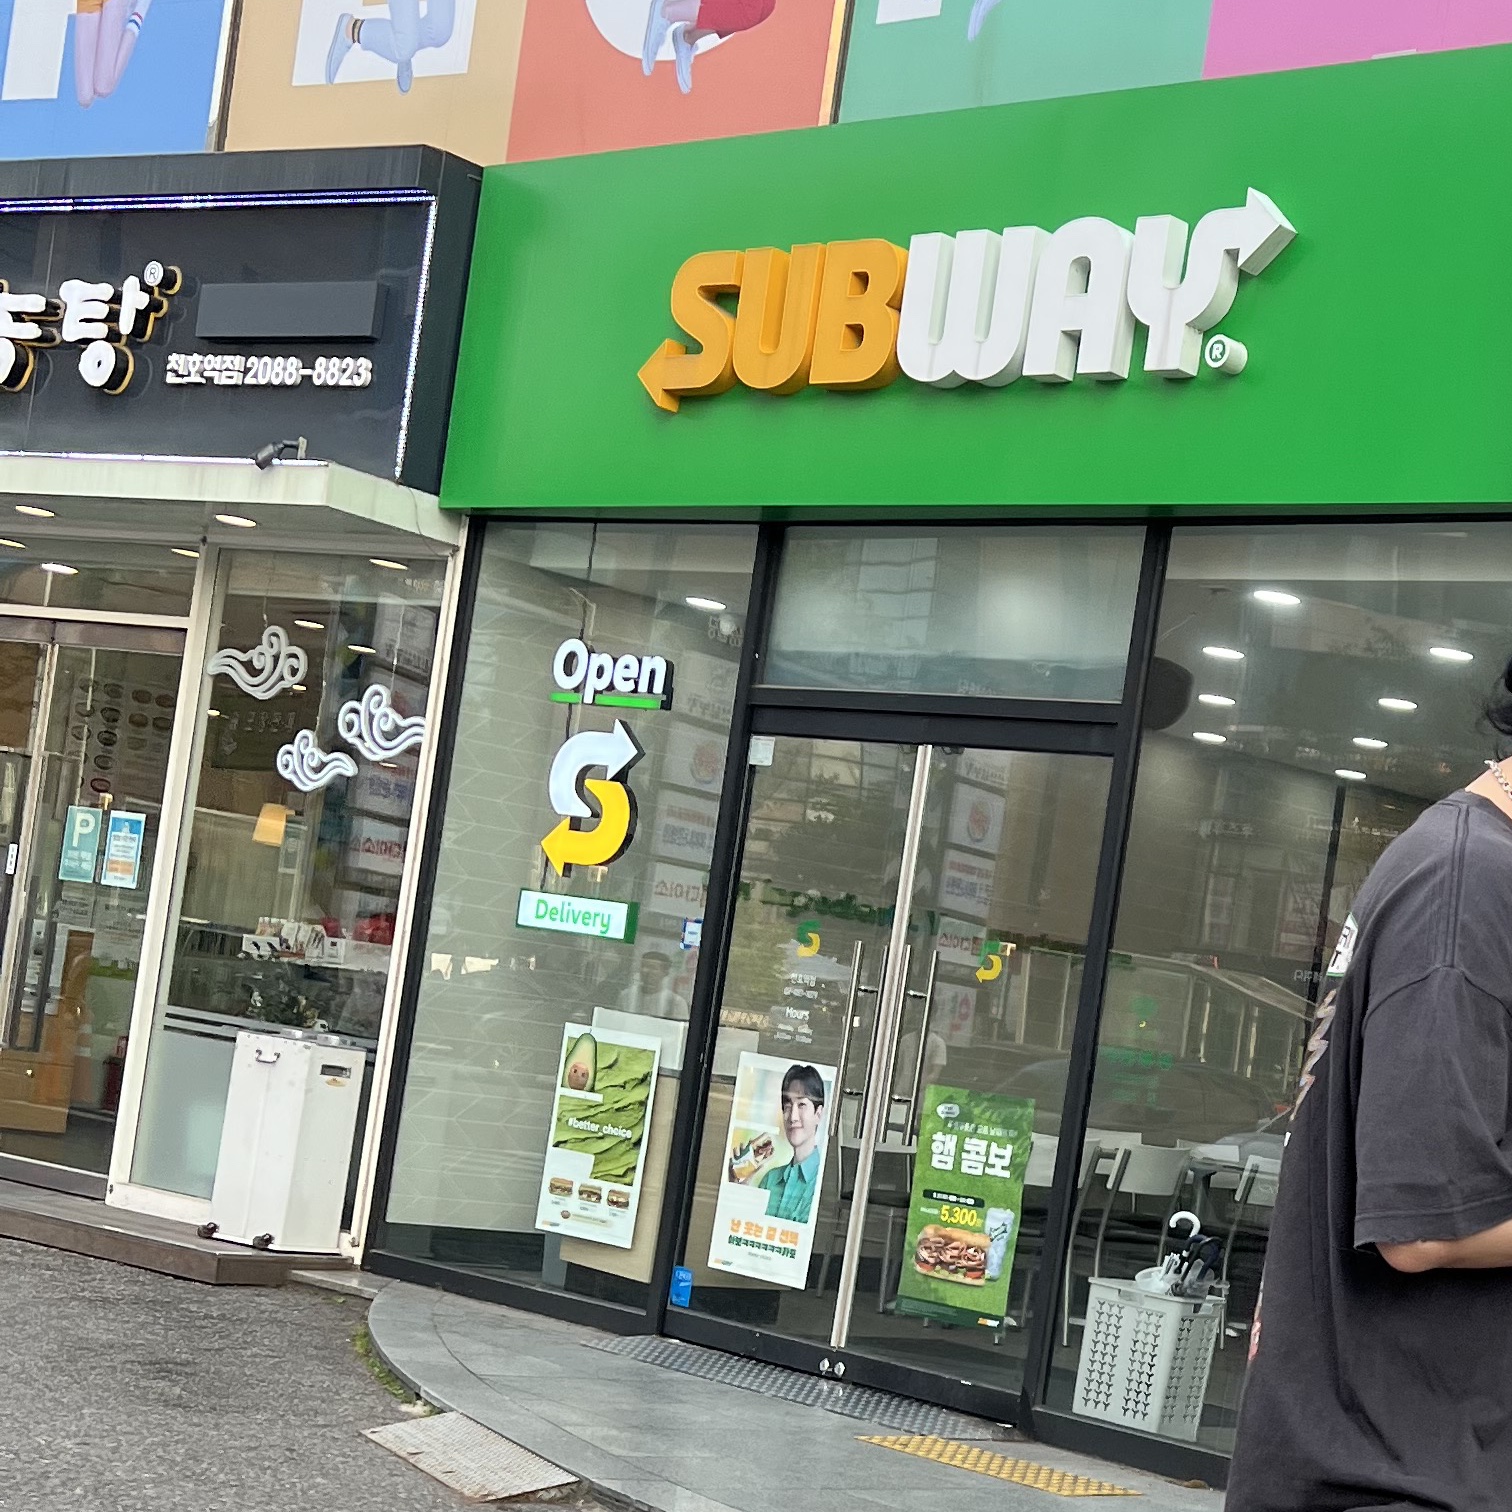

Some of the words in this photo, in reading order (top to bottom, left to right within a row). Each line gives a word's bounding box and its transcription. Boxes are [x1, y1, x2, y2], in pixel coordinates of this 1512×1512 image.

[637, 186, 1298, 413] SUBWAY
[165, 352, 244, 386] 천호역점
[244, 355, 372, 388] 2088-8823
[553, 638, 667, 704] Open
[534, 897, 612, 936] Delivery
[785, 1006, 810, 1021] Hours
[931, 1131, 958, 1171] 햄
[960, 1136, 1013, 1179] 콤보
